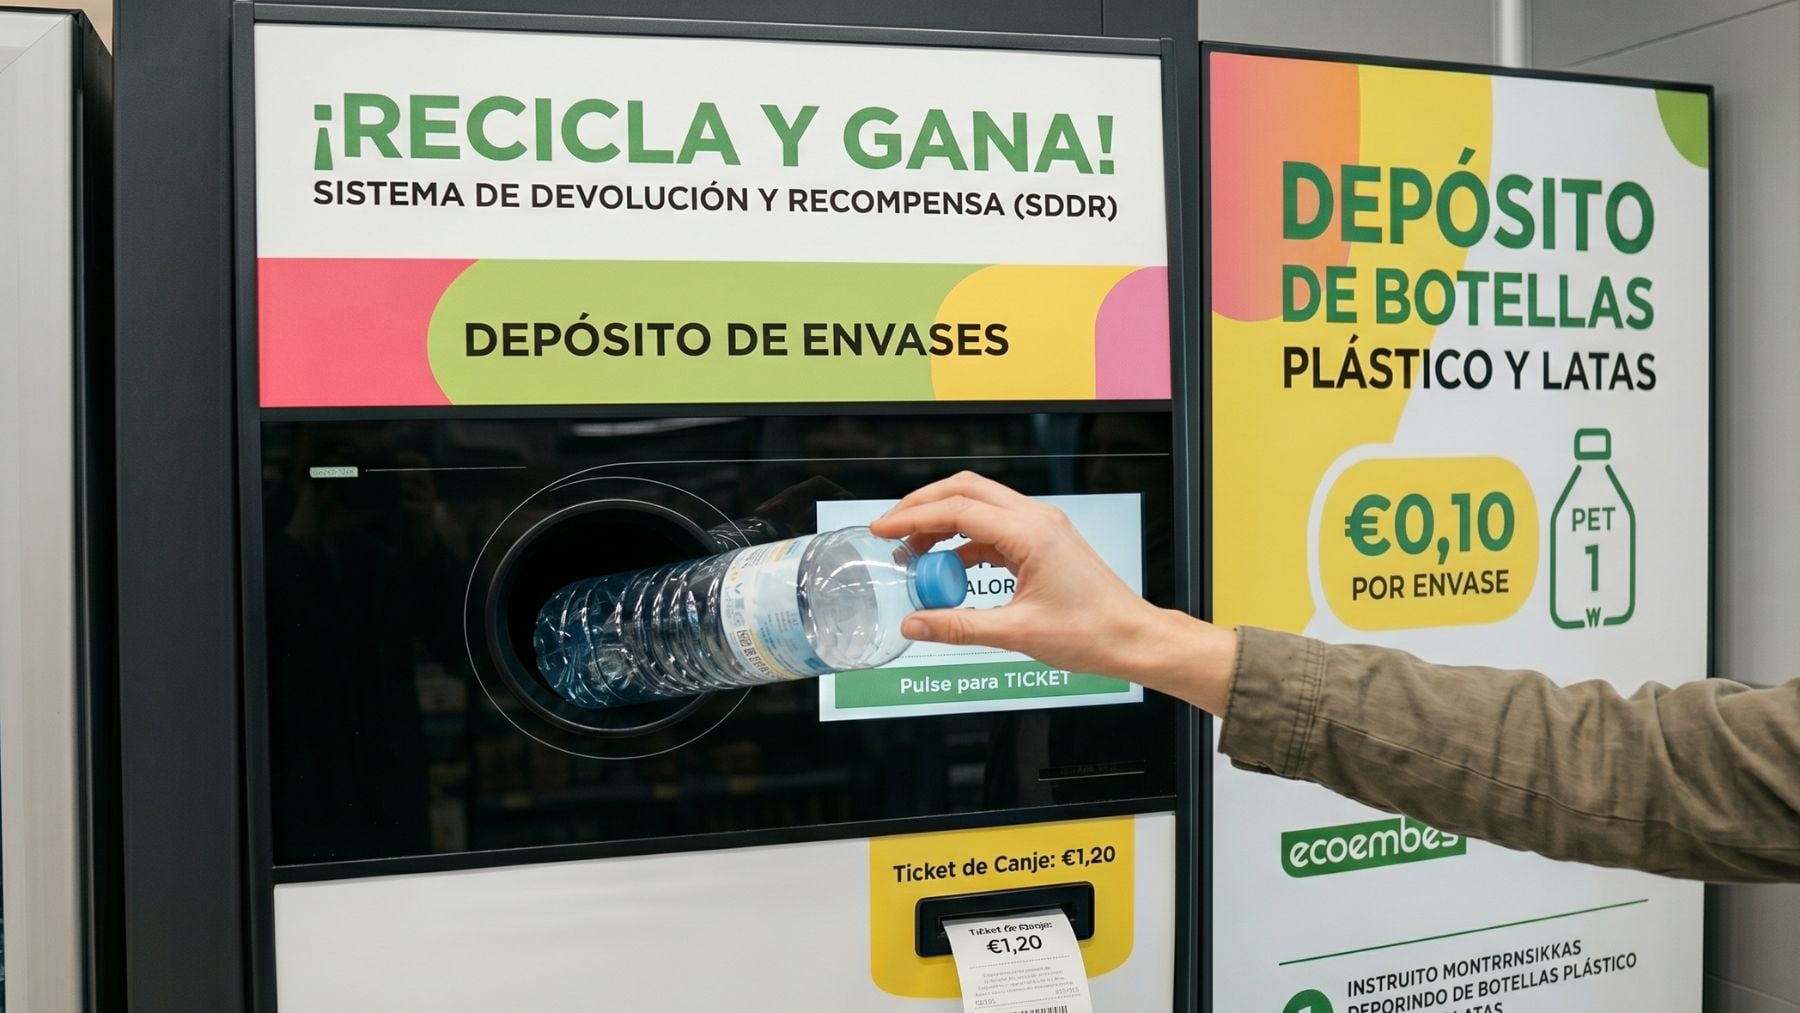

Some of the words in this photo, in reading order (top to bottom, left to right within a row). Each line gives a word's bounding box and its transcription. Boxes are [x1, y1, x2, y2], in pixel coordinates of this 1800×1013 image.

[313, 93, 742, 171] ¡RECICLA
[759, 105, 820, 168] Y
[843, 107, 1115, 175] GANA!
[313, 180, 465, 207] SISTEMA
[475, 183, 520, 208] DE
[531, 179, 749, 212] DEVOLUCIÓN
[758, 187, 779, 212] Y
[788, 189, 1006, 216] RECOMPENSA
[1013, 192, 1118, 222] (SDDR)
[1282, 147, 1655, 255] DEPÓSITO
[1282, 264, 1358, 324] DE
[1376, 267, 1655, 330] BOTELLAS
[465, 311, 712, 357] DEPÓSITO
[727, 322, 788, 357] DE
[803, 322, 1009, 357] ENVASES
[1283, 335, 1493, 390] PLÁSTICO
[1504, 351, 1531, 390] Y
[1543, 351, 1657, 391] LATAS
[1344, 491, 1516, 565] €0,10
[1571, 506, 1616, 532] PET
[967, 578, 1015, 596] ALOR
[1352, 574, 1405, 601] POR
[1413, 569, 1510, 598] ENVASE
[1584, 543, 1600, 592] 1
[900, 676, 952, 694] Pulse
[957, 677, 999, 694] para
[1004, 669, 1071, 688] TICKET
[893, 861, 957, 883] Ticket
[963, 858, 988, 877] de
[994, 851, 1056, 876] Canje:
[1061, 846, 1116, 868] €1,20
[1289, 814, 1459, 868] ecoembes
[986, 935, 1043, 955] €1,20
[1347, 966, 1439, 998] INSTRUITO
[1443, 939, 1583, 980] MONTRRNSIKKAS
[1453, 983, 1474, 1003] DE
[1478, 968, 1559, 998] BOTELLAS
[1563, 952, 1638, 982] PLÁSTICO
